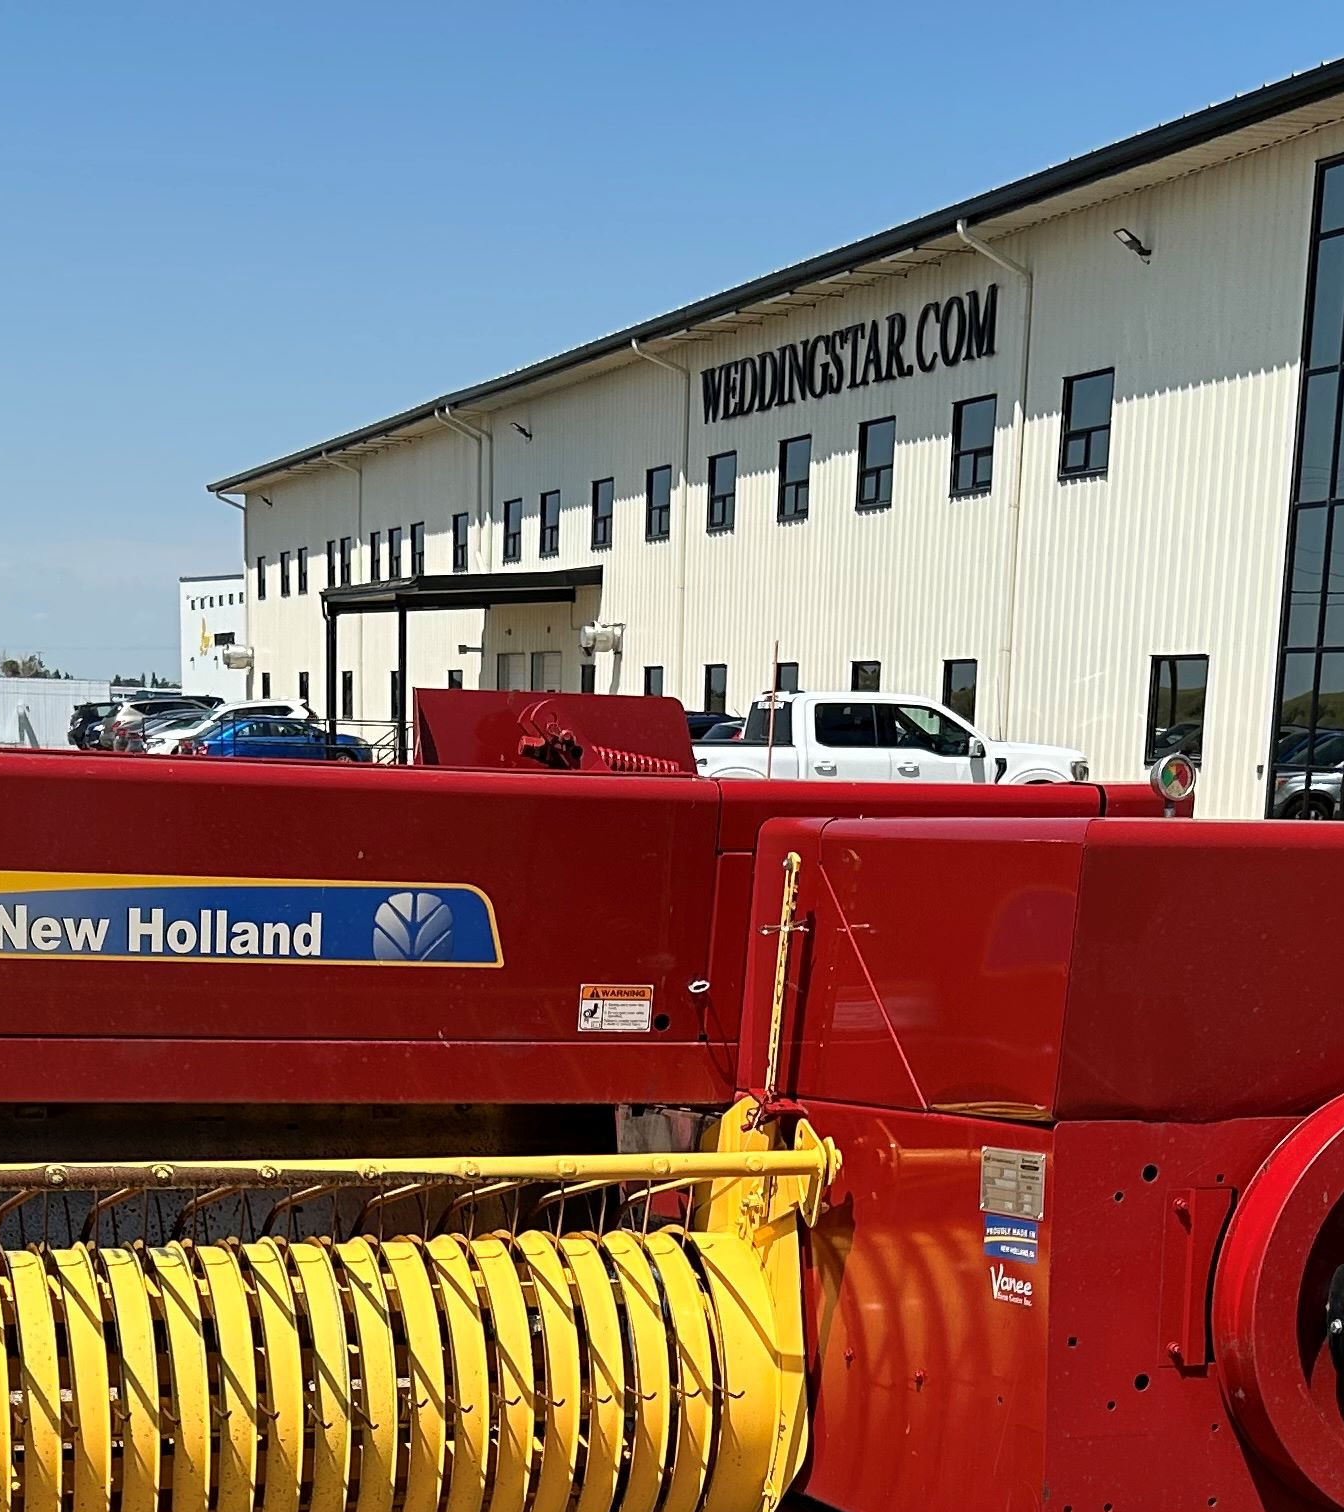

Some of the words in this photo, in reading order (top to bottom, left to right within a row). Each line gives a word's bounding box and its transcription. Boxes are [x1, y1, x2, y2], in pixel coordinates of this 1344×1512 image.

[700, 283, 998, 424] WEDDINGSTAR.COM
[128, 907, 322, 958] Holland
[602, 989, 646, 998] WARNING
[990, 1263, 1033, 1299] Vanee
